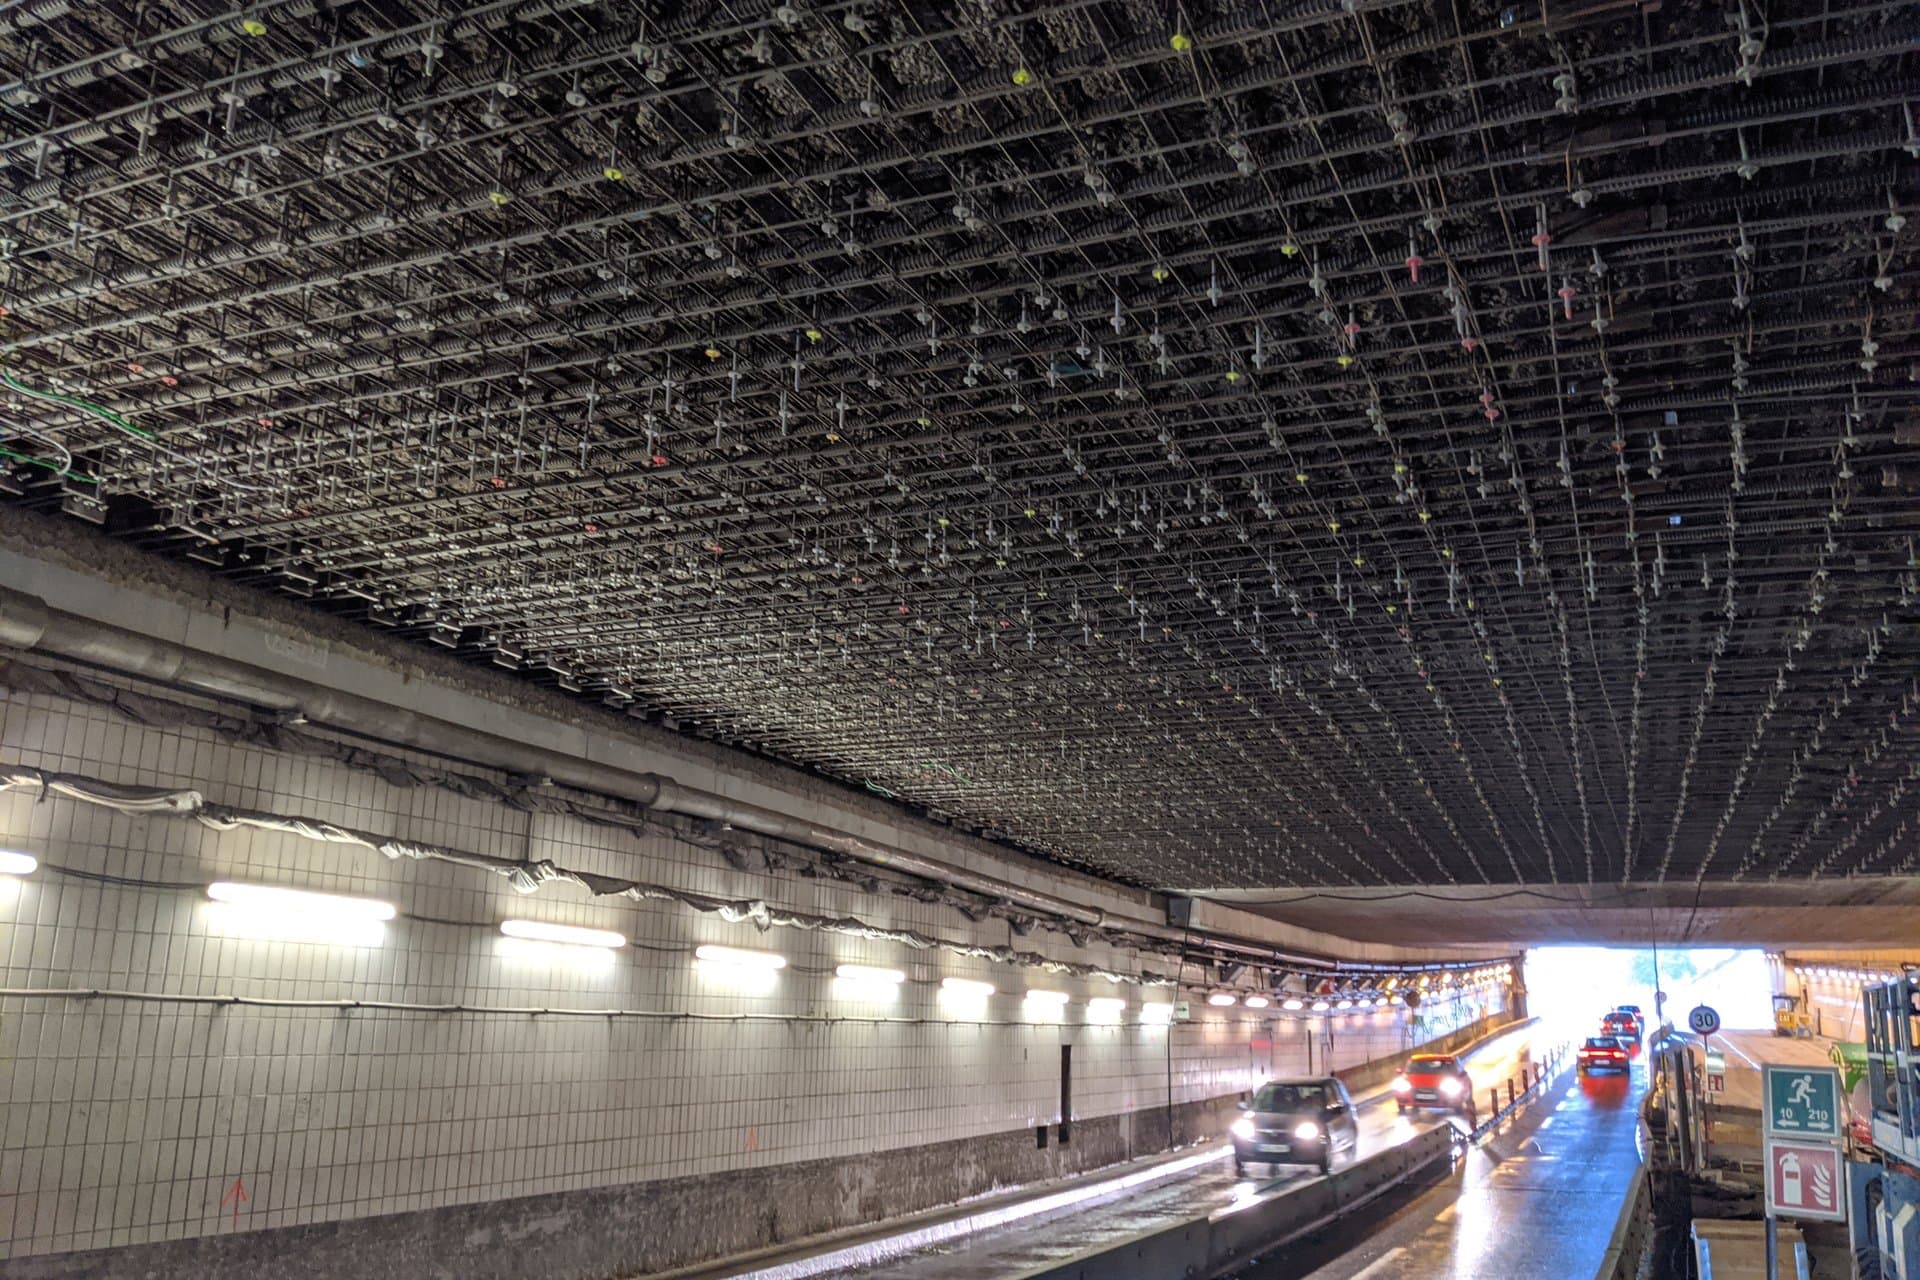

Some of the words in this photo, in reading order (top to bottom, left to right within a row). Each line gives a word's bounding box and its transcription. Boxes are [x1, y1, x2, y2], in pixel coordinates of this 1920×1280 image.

[1694, 1012, 1714, 1027] 30
[1780, 1107, 1793, 1119] 10
[1808, 1109, 1829, 1121] 210
